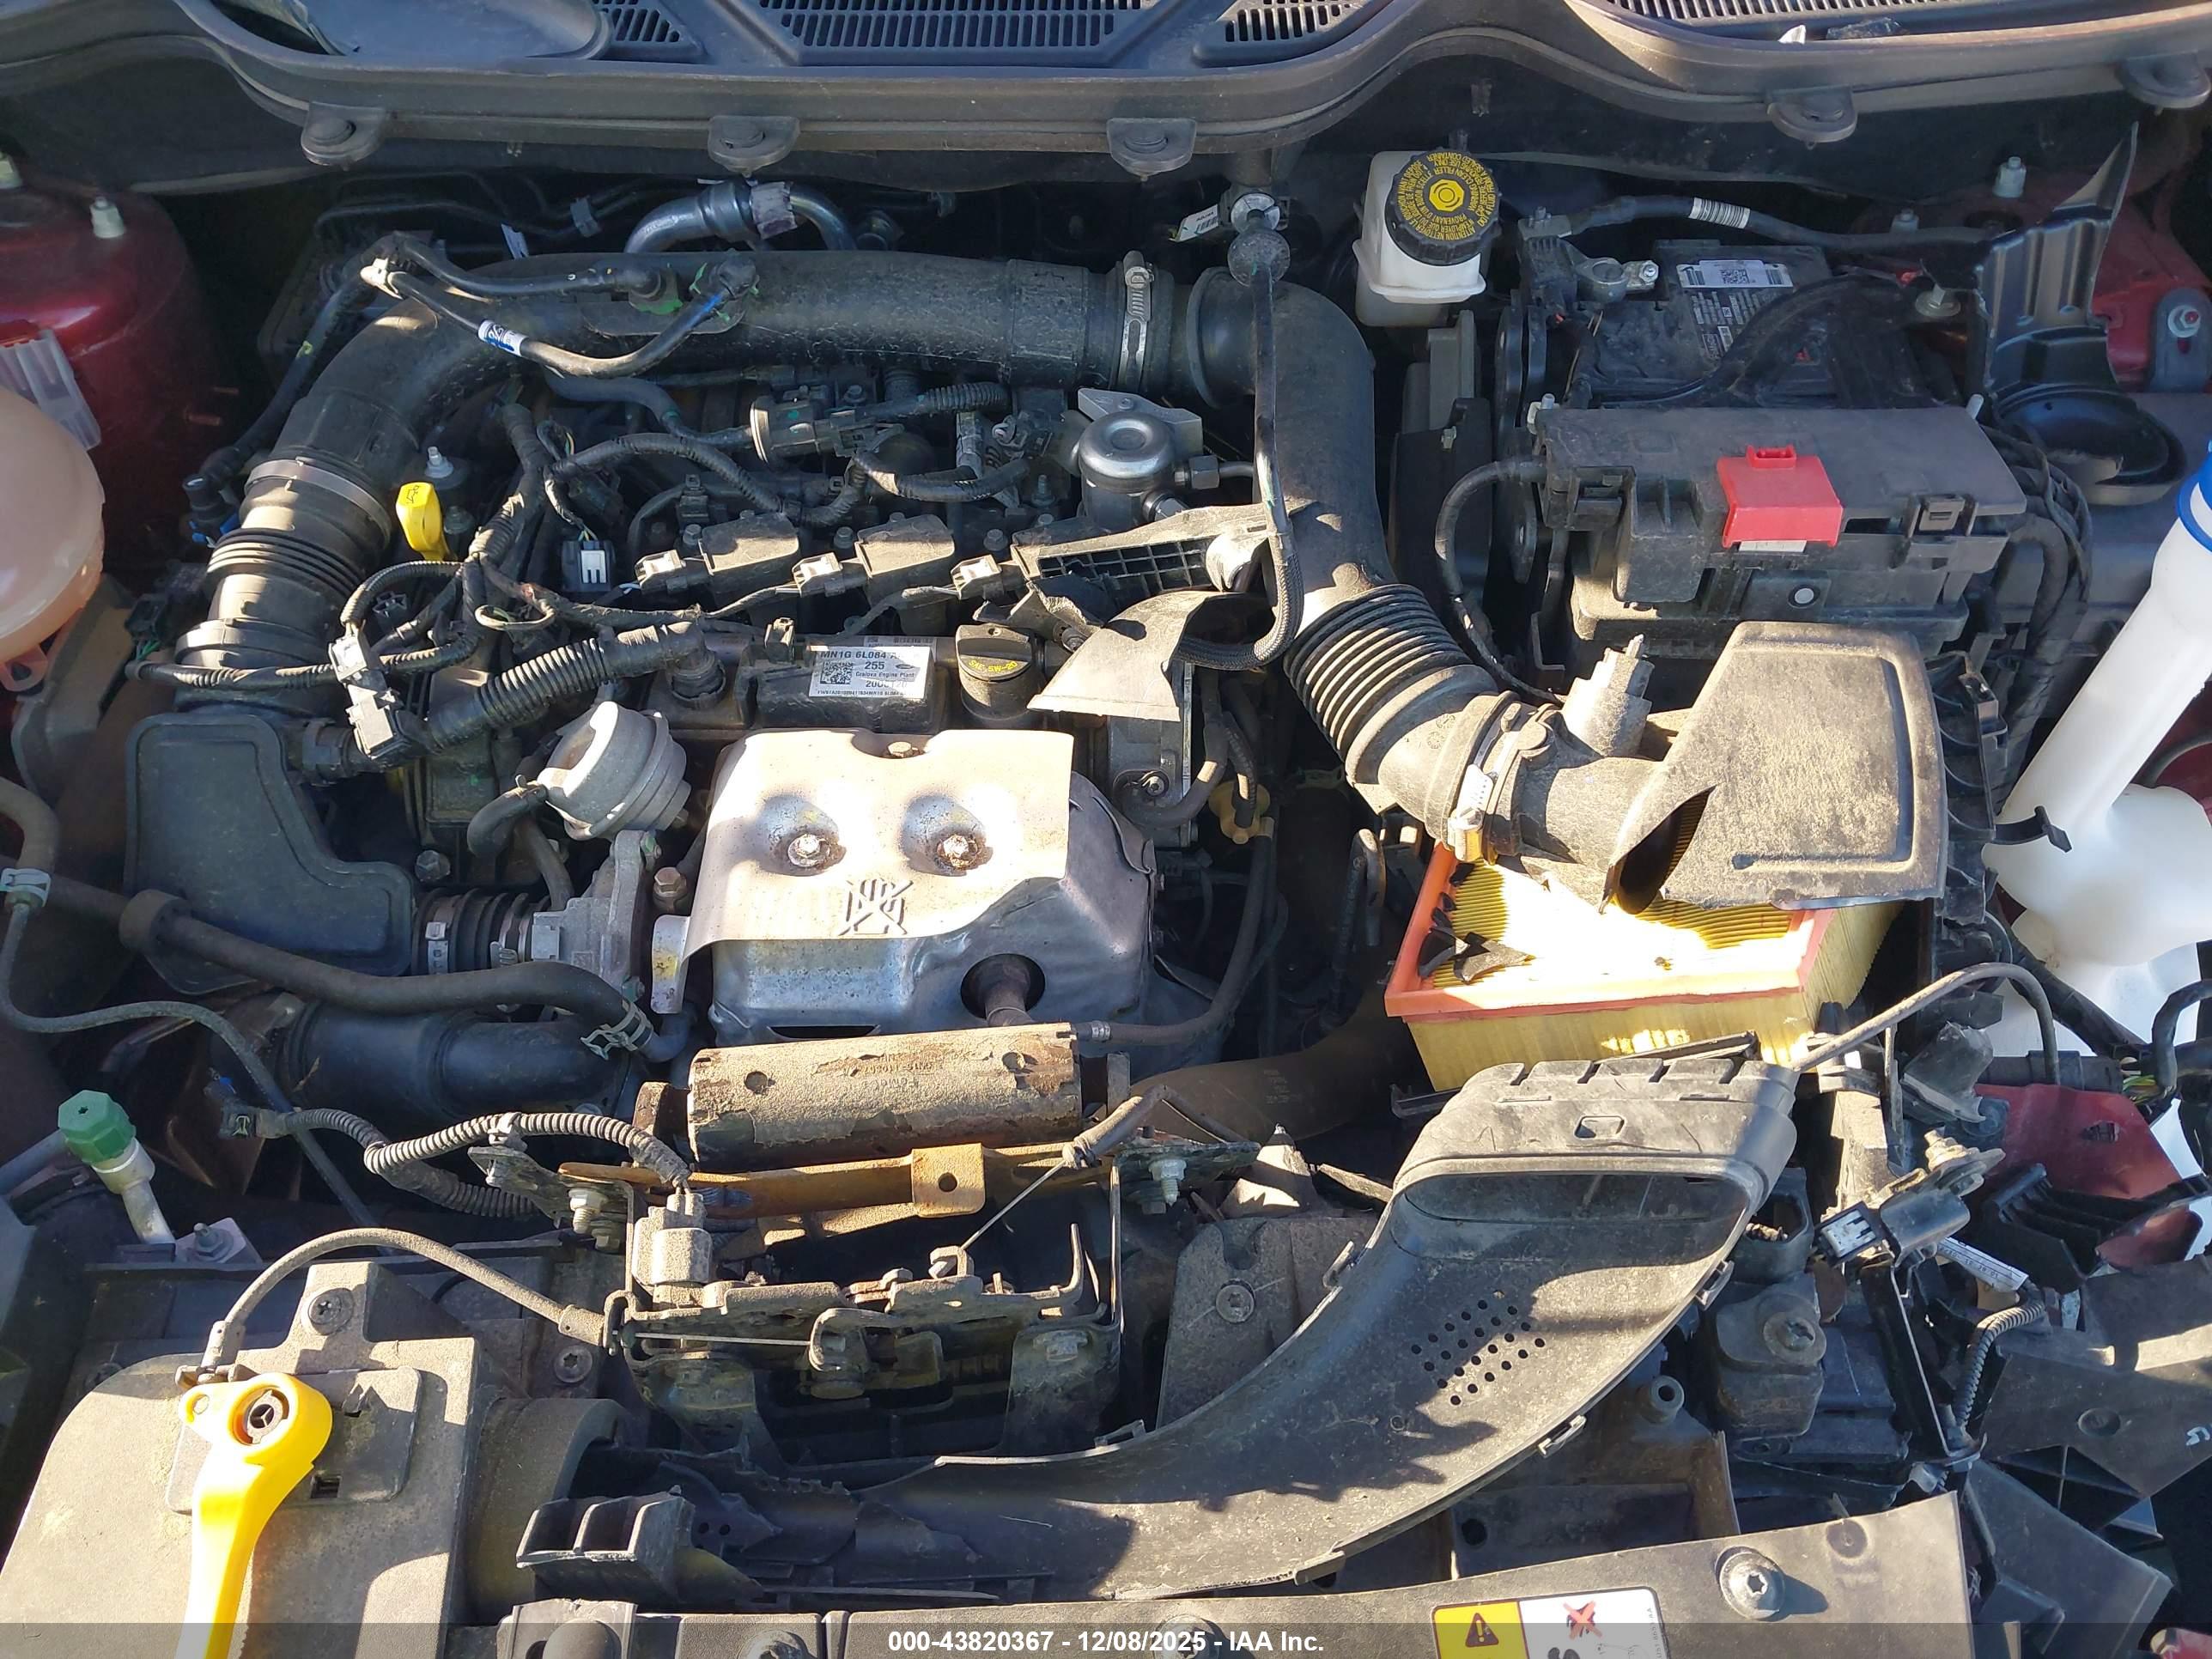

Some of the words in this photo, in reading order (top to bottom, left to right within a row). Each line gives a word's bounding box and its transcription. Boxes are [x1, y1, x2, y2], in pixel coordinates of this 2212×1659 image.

[1426, 151, 1462, 161] CONTAINER
[1432, 158, 1448, 167] ONLY
[1449, 159, 1461, 167] USE
[1432, 166, 1456, 175] FILLER
[1462, 155, 1485, 173] SEALED
[1455, 168, 1474, 185] CLEAN
[1483, 175, 1495, 192] FROM
[1397, 176, 1409, 194] AVANT
[1414, 188, 1424, 206] BIDON
[1468, 182, 1480, 213] WARNING
[1486, 193, 1495, 210] FLUID
[1398, 194, 1413, 221] BOUCHON
[1407, 200, 1422, 220] LIQUIDE
[1474, 204, 1486, 217] CAP
[1431, 212, 1468, 225] PROVENANT
[1414, 223, 1443, 240] NETTOYER
[1426, 222, 1440, 232] QUE
[1445, 225, 1476, 240] ATTENTION
[820, 650, 852, 659] MN1G
[855, 650, 887, 659] 6L084
[864, 661, 885, 671] 255
[969, 659, 985, 670] SAE
[988, 661, 1018, 672] 5W-20
